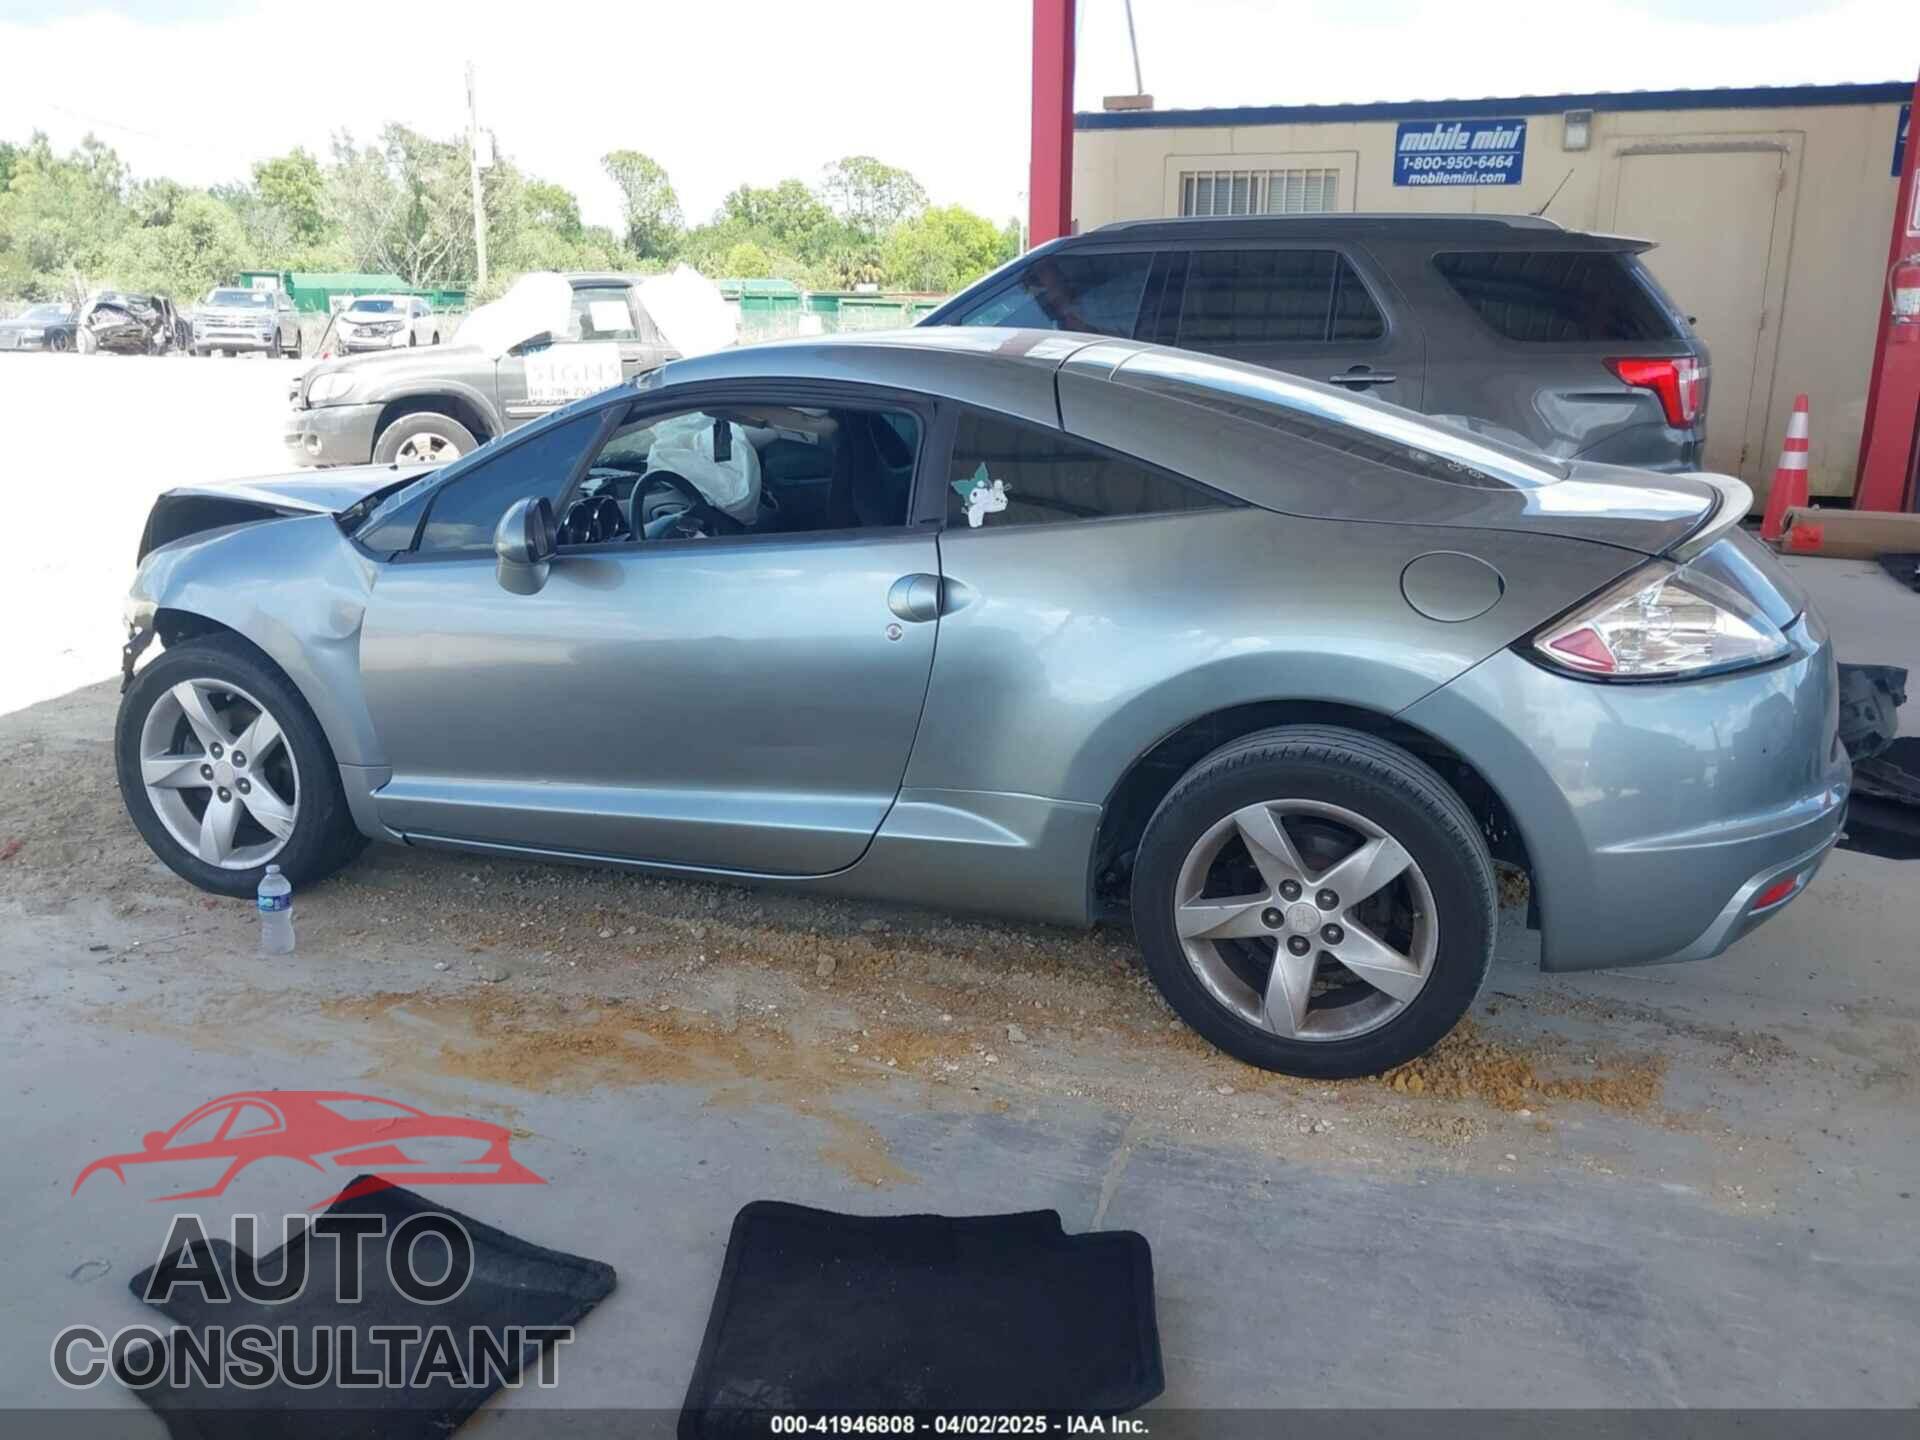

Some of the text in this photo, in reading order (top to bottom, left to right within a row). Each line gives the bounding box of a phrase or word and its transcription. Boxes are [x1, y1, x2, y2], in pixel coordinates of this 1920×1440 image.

[1401, 123, 1521, 150] mobile mini
[1403, 155, 1513, 170] 1-800-950-6464
[1409, 172, 1506, 184] mobilemini.com
